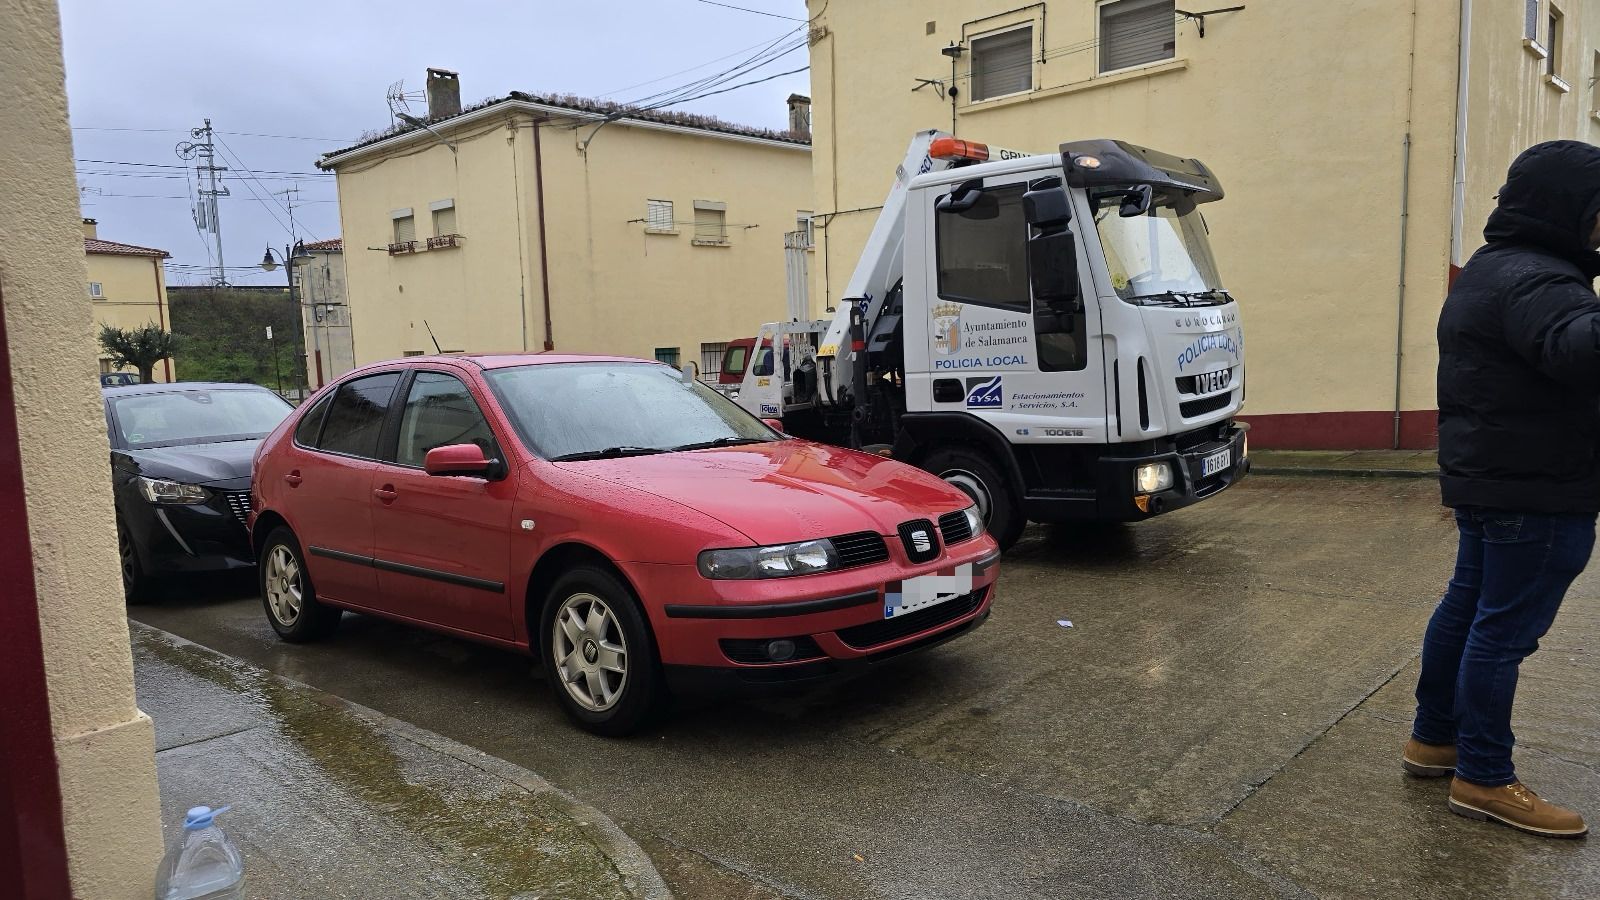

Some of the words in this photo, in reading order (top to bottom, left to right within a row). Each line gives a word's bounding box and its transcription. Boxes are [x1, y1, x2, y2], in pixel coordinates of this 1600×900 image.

[963, 318, 1027, 335] Ayuntamiento
[965, 337, 976, 348] de
[978, 334, 1028, 348] Salamanca
[1177, 333, 1217, 373] POLICIA
[1218, 333, 1239, 361] LOCAL
[935, 357, 983, 370] POLICIA
[986, 355, 1028, 367] LOCAL
[1195, 369, 1230, 396] IVECO
[968, 394, 1001, 403] EYSA
[1012, 390, 1085, 400] Estacionamientos
[1018, 400, 1058, 409] Servicios,
[1060, 400, 1079, 408] S.A.
